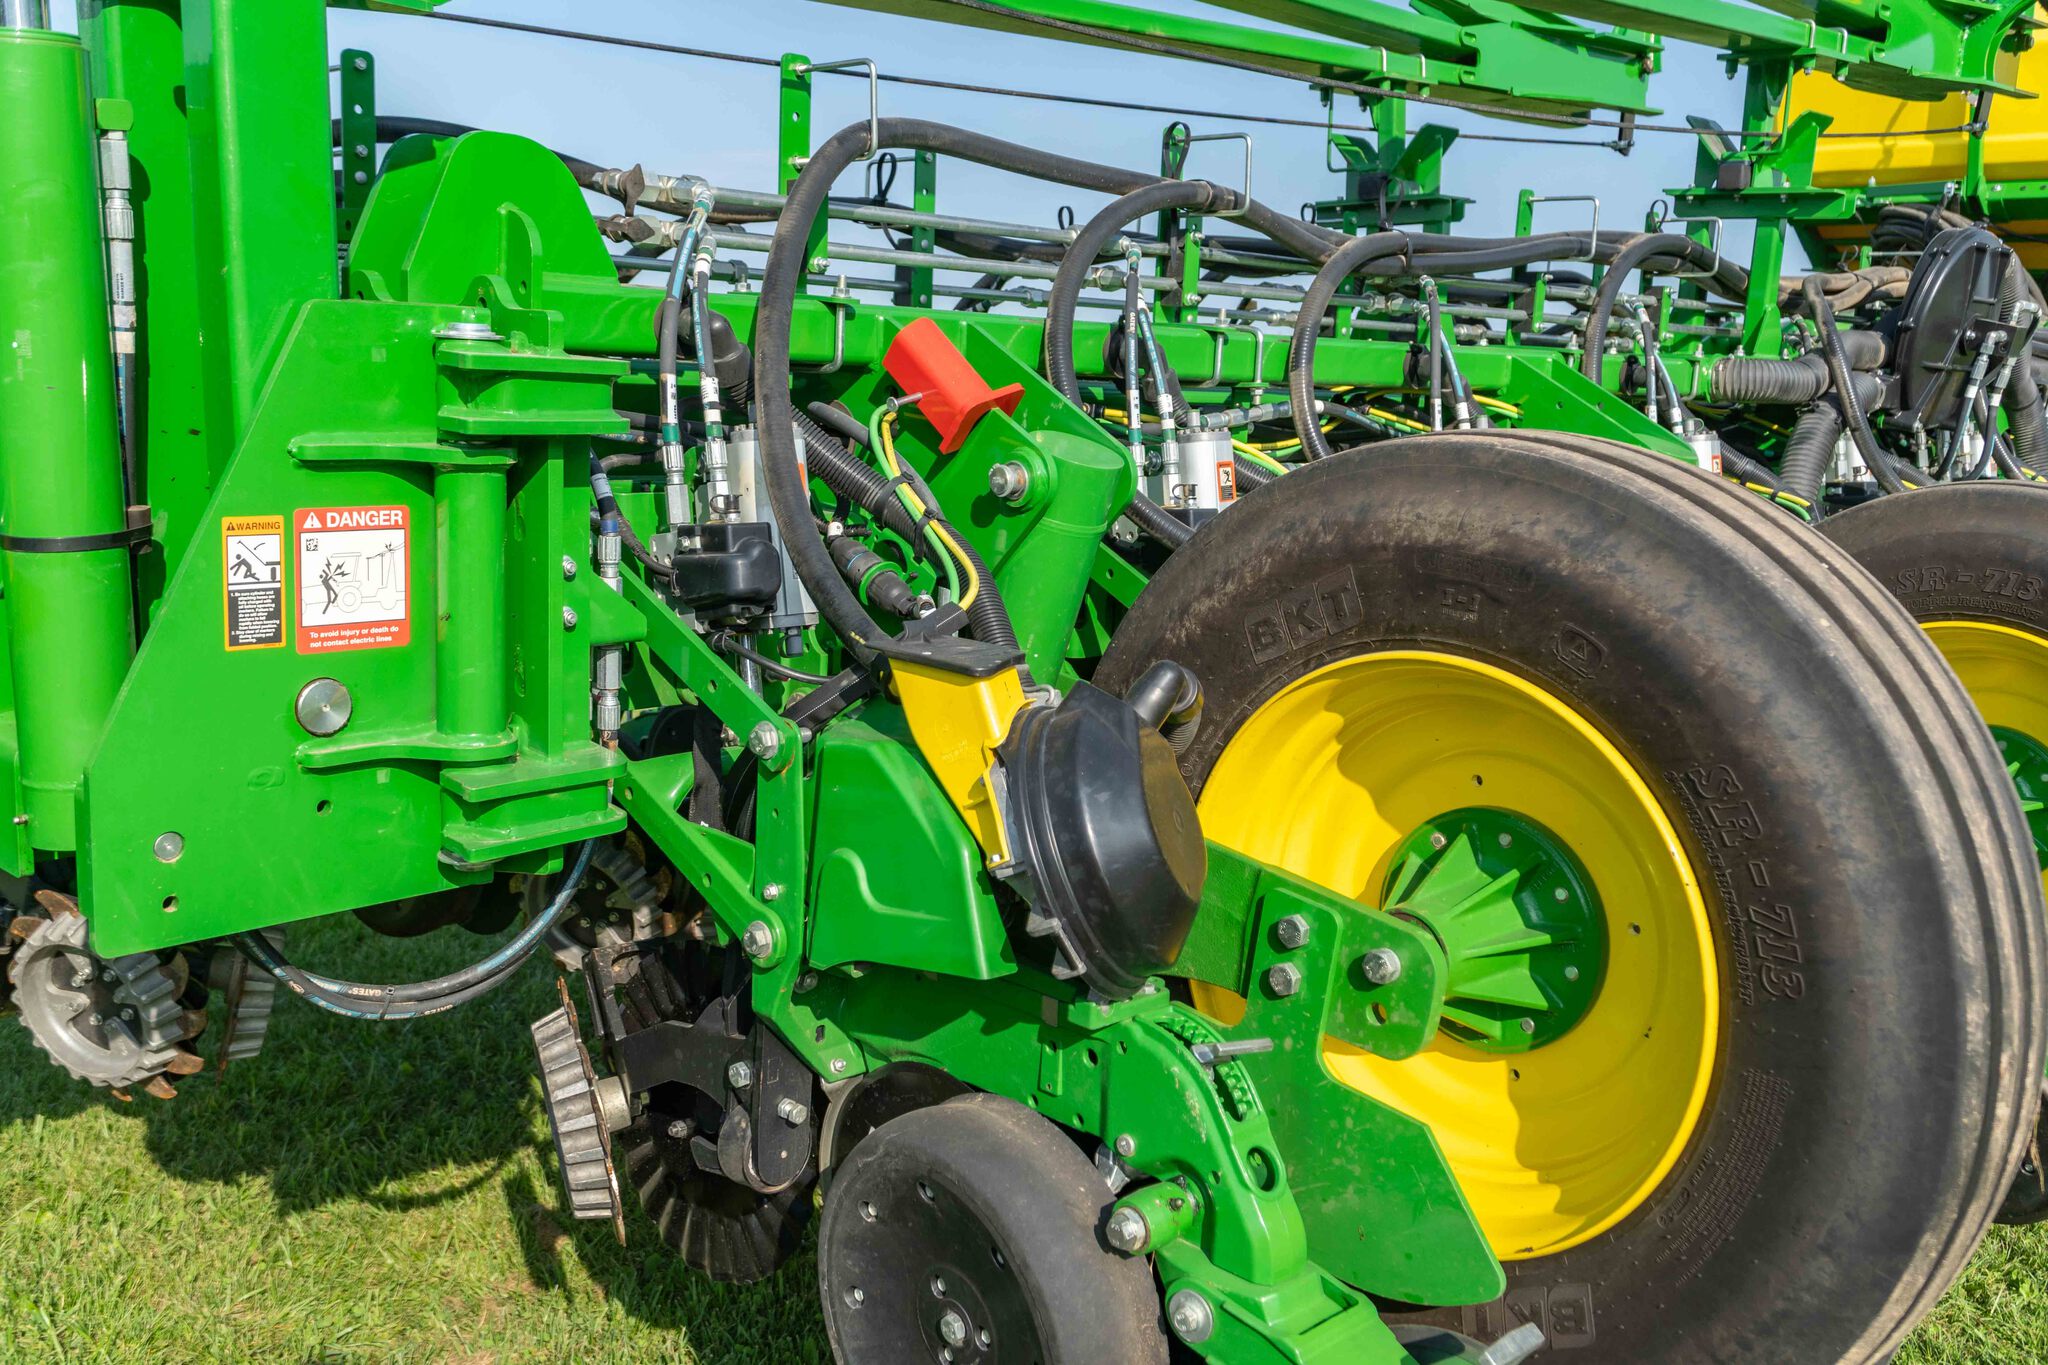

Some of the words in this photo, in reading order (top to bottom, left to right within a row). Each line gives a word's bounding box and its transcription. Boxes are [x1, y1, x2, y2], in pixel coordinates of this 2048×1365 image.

[326, 510, 403, 528] DANGER
[236, 521, 281, 531] WARNING
[1247, 577, 1356, 659] BKT
[310, 631, 319, 639] To
[320, 630, 339, 638] avoid
[340, 628, 360, 637] injury
[370, 626, 389, 634] death
[310, 640, 322, 648] not
[323, 639, 349, 647] contact
[350, 636, 375, 645] electric
[1749, 903, 1806, 1001] 713
[350, 986, 382, 997] GATES
